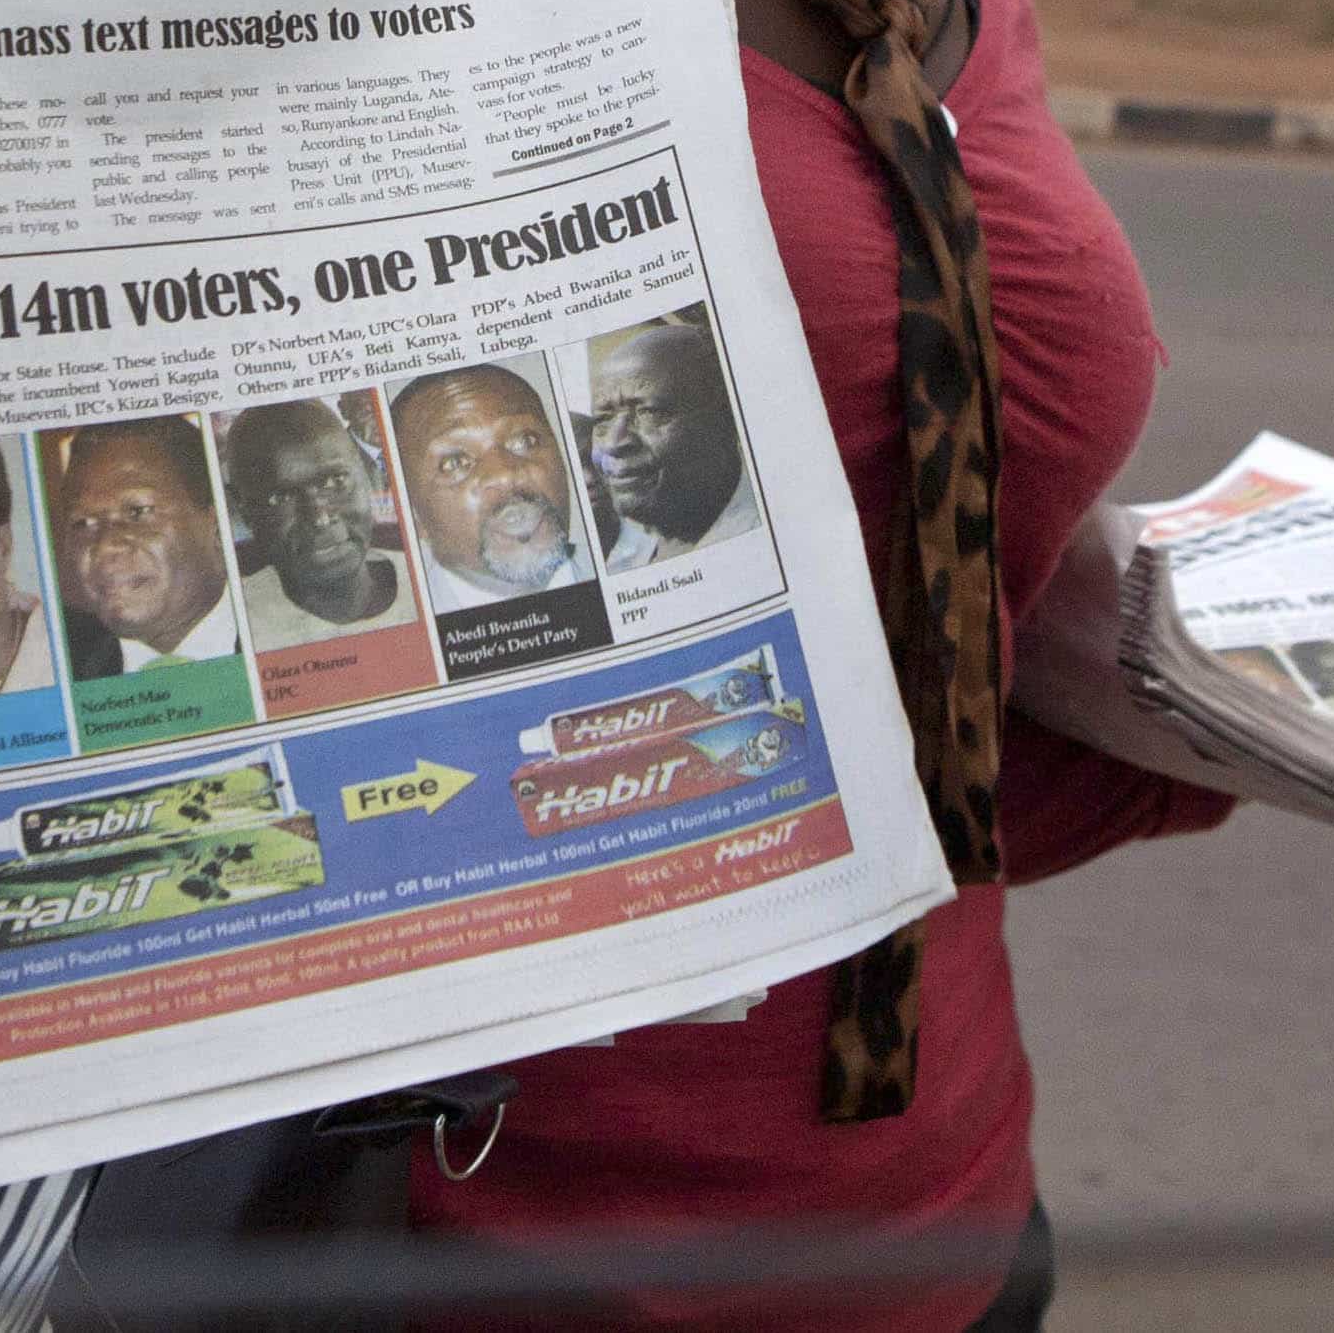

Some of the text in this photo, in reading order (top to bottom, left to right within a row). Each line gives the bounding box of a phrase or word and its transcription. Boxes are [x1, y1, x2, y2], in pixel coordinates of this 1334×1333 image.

[82, 15, 149, 53] text
[161, 10, 318, 50] messages
[328, 7, 360, 41] to
[370, 3, 475, 39] voters
[469, 18, 641, 75] es to the people was a new
[277, 69, 449, 95] in various languages. They
[473, 36, 646, 92] campaign strategy to can-
[279, 87, 454, 114] were mainly Luganda, Ate-
[477, 82, 562, 109] vass for votes.
[557, 91, 587, 109] must
[598, 84, 613, 97] be
[622, 69, 654, 88] lucky
[485, 85, 659, 145] that they spoke to the presi-
[512, 116, 633, 161] Continued on Page 2
[121, 266, 300, 327] voters,
[315, 250, 416, 303] one
[424, 175, 680, 286] President
[472, 250, 691, 317] PDP's Abed Bwanika and in-
[477, 263, 694, 337] dependent candidate Samuel
[231, 312, 456, 357] DP's Norbert Mao, UPC's Olara
[235, 332, 461, 376] Otunnu, UFA's Beti Kamya.
[481, 335, 537, 354] Lubega.
[238, 347, 465, 395] Others are PPP's Bidandi Ssali,
[617, 568, 703, 605] Bidandi Ssali
[446, 612, 549, 646] Abedi Bwanika
[621, 606, 648, 625] PPP
[447, 627, 577, 666] People's Devt Party
[359, 778, 438, 811] Free
[23, 956, 64, 976] Habit
[69, 944, 131, 967] Fluoride
[216, 916, 257, 938] Habit
[261, 904, 310, 927] Herbal
[354, 888, 387, 907] Free
[395, 879, 418, 897] OR
[422, 875, 451, 891] Buy
[455, 863, 495, 885] Habit
[499, 850, 547, 874] Herbal
[628, 822, 667, 844] Habit
[671, 805, 730, 832] Fluoride
